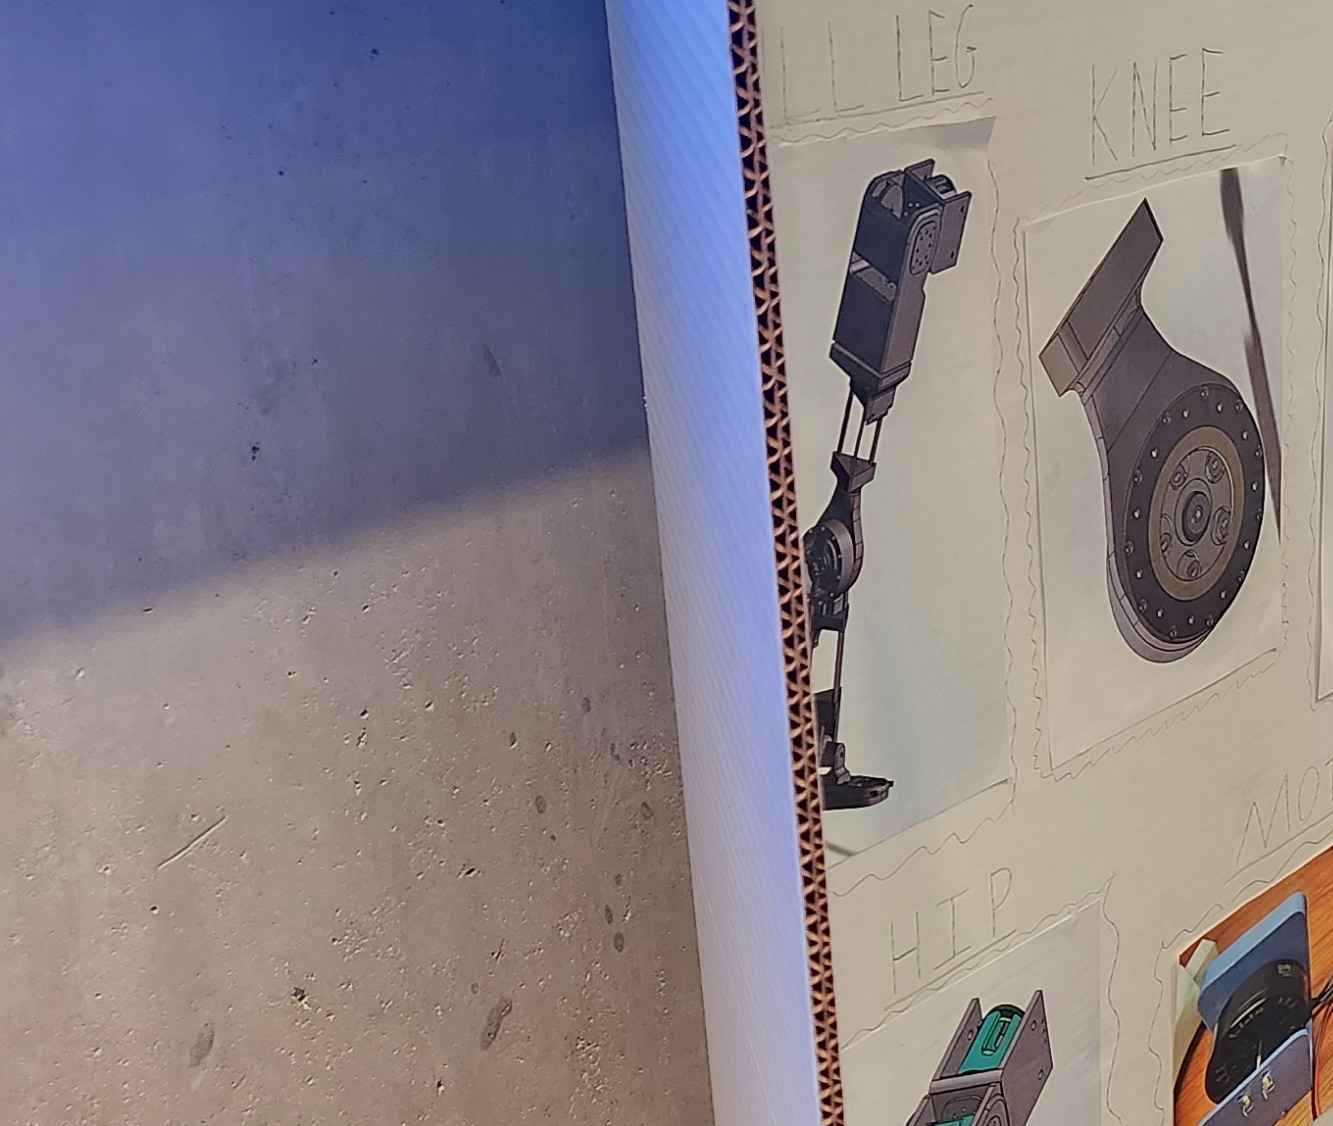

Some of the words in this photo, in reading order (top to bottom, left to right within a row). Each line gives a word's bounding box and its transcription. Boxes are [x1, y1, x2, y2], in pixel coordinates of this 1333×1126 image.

[894, 4, 977, 102] LEG
[1091, 48, 1230, 167] KNEE
[890, 868, 1012, 994] HIP
